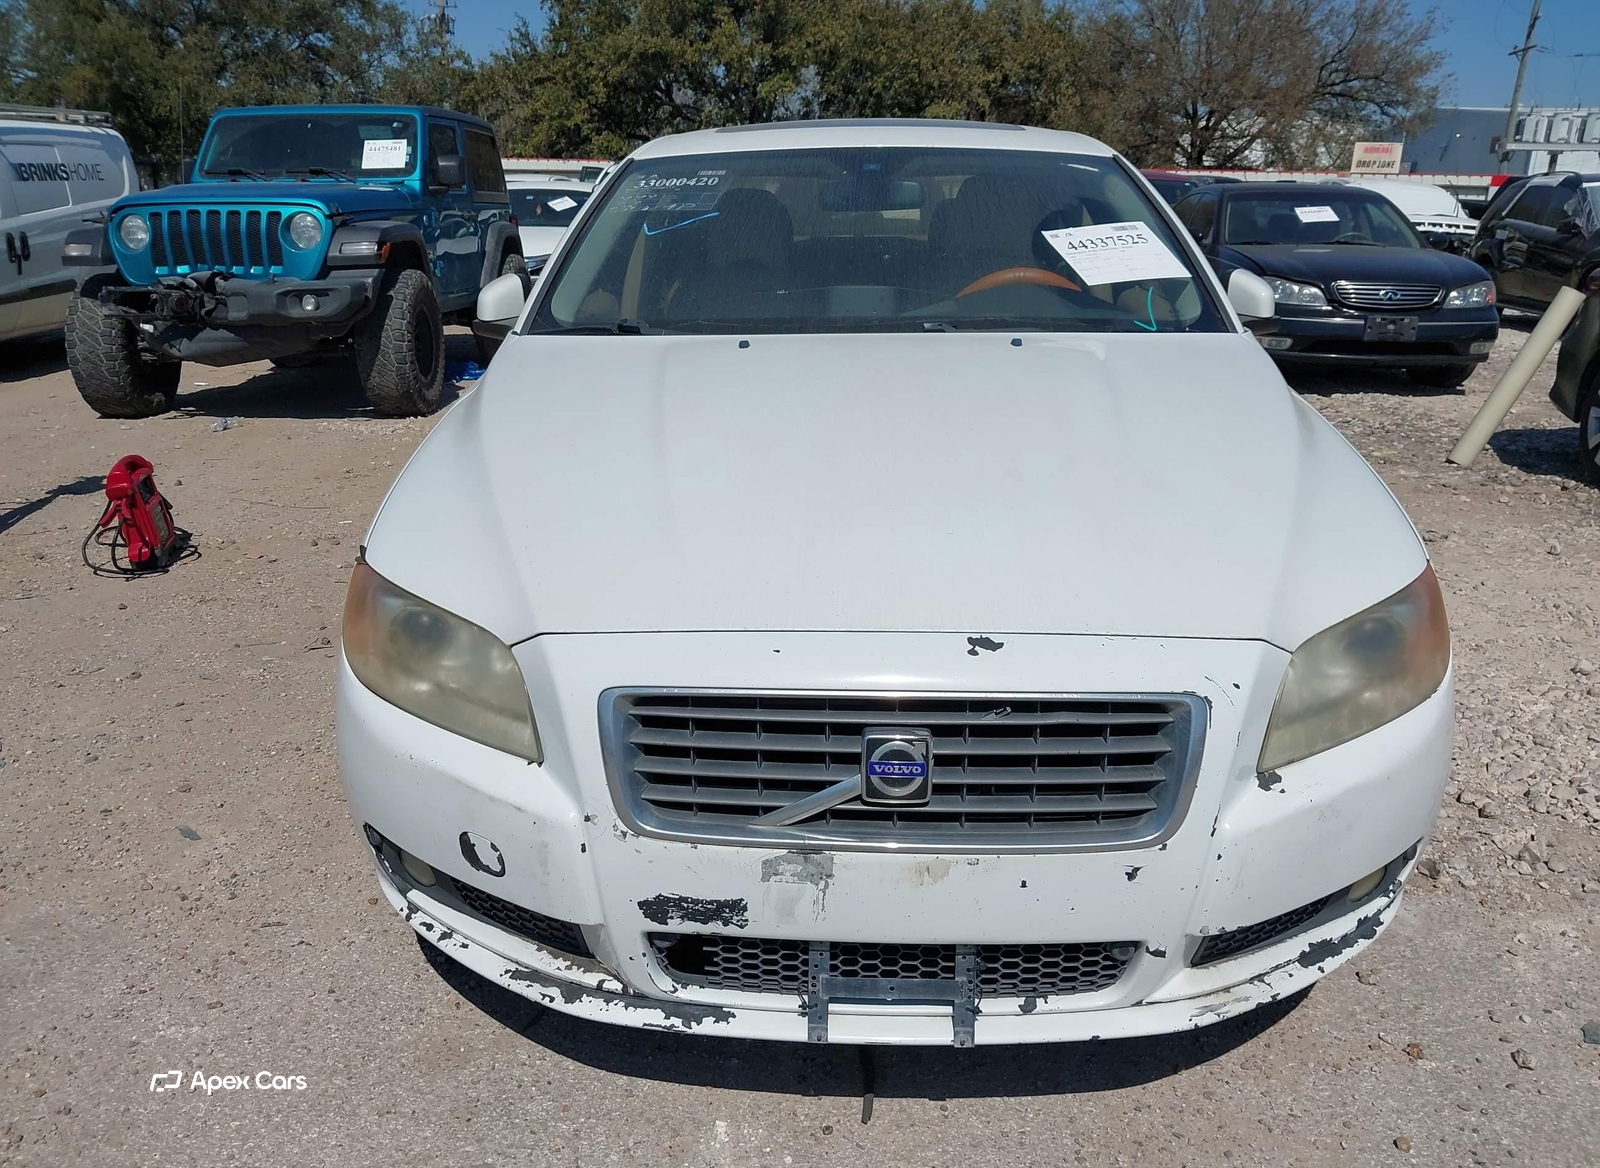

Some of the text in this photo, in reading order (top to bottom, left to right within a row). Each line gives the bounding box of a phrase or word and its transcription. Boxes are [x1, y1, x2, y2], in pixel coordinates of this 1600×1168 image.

[633, 176, 719, 190] 33000420
[1067, 233, 1149, 251] 44337525
[873, 764, 922, 774] VOLVO
